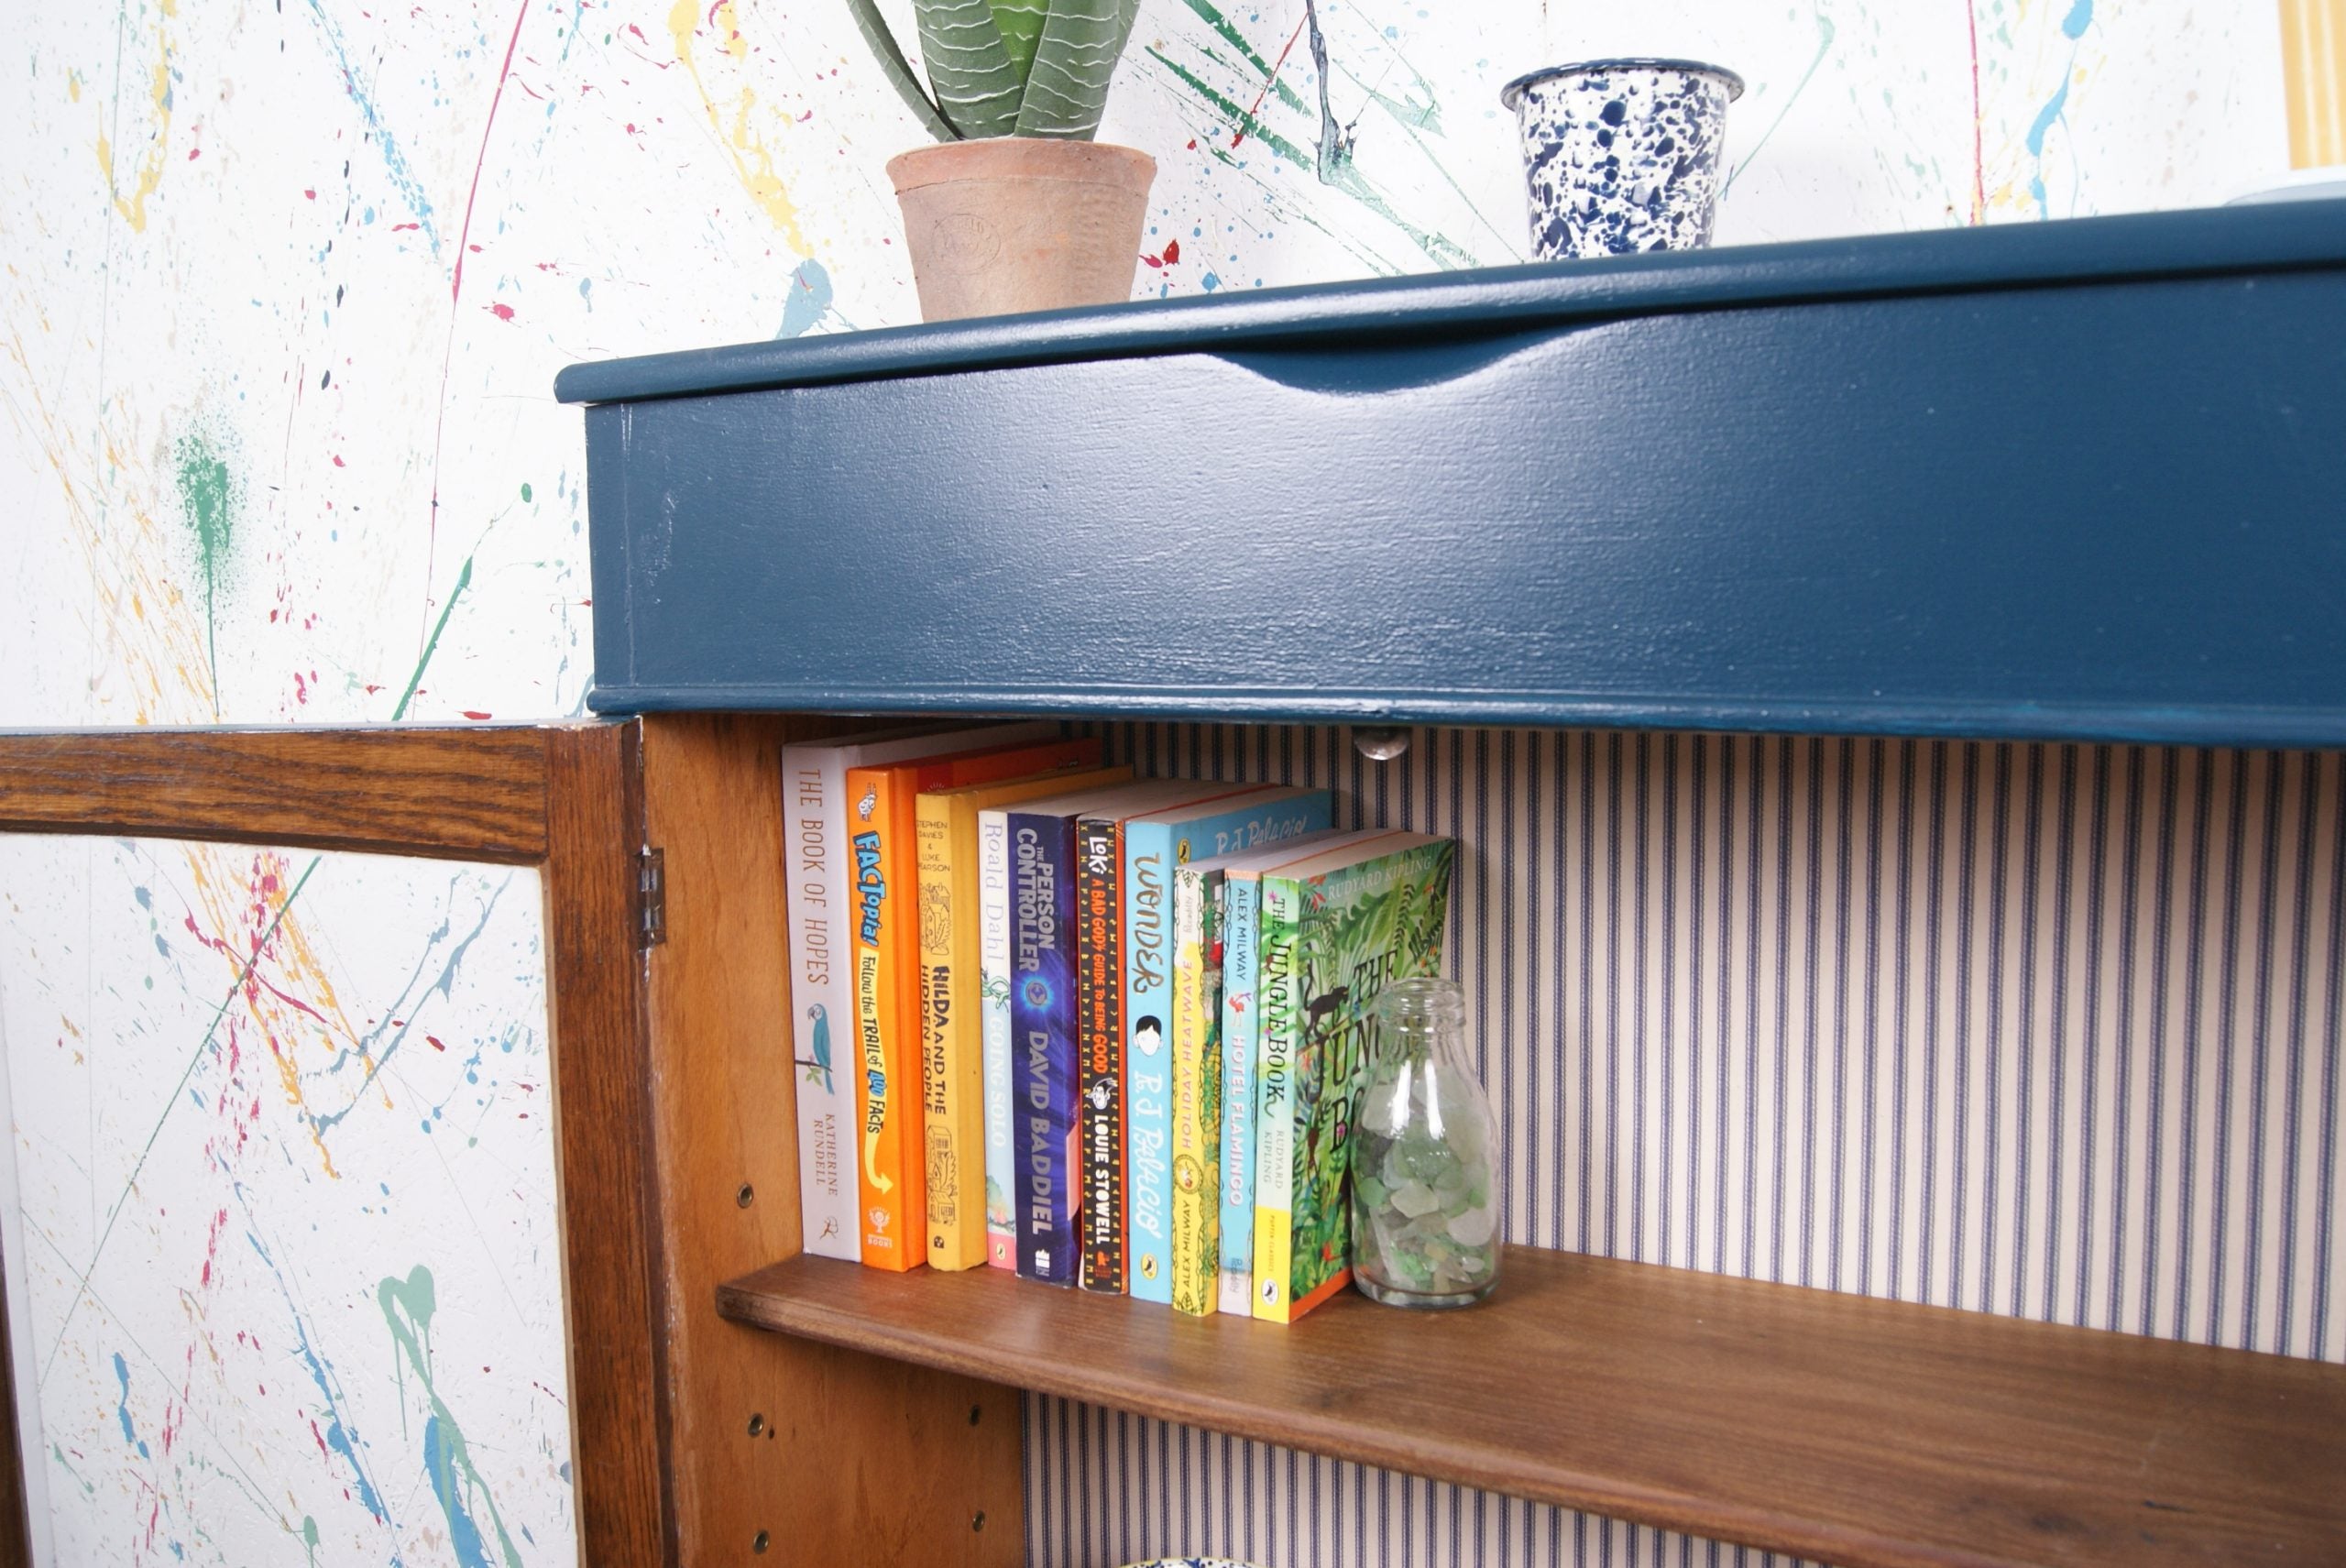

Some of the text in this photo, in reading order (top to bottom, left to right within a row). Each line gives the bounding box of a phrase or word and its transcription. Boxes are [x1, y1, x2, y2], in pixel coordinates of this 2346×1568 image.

[918, 830, 944, 839] DAVIES
[922, 853, 941, 861] LUKE
[799, 769, 828, 985] THE BOOK OF HOPES
[984, 823, 1005, 961] Roald Dahl
[1016, 828, 1040, 972] CONTROLLER
[1036, 846, 1055, 949] THE PERSON
[1091, 879, 1105, 887] A
[1091, 890, 1106, 916] BAD
[1329, 856, 1432, 901] RUDYARD KIPLING
[1236, 887, 1249, 981] ALEX MILWAY
[861, 956, 877, 992] Follow
[1093, 953, 1106, 986] GUIDE
[1354, 949, 1398, 1003] THE
[861, 995, 876, 1014] the
[863, 1018, 881, 1054] TRAIL
[1094, 1001, 1106, 1032] BEING
[1265, 897, 1291, 1118] THE JUNGLE BOOK
[868, 1055, 882, 1068] of
[921, 965, 933, 1112] HIDDEN PEOPLE
[932, 965, 951, 1115] HILDA AND THE
[1092, 1034, 1108, 1074] GOOD
[1181, 959, 1193, 1149] HOLIDAY HEATWAVE
[990, 1016, 1007, 1147] GOING SOLO
[815, 1119, 825, 1186] RUNDELL
[826, 1113, 839, 1196] KATHERINE
[1029, 1031, 1053, 1235] DAVID BADDIEL
[1229, 1036, 1246, 1207] HOTEL FLAMINGO
[1093, 1114, 1111, 1245] LOUIE STOWELL
[1263, 1131, 1273, 1184] KIPLING
[1275, 1129, 1286, 1190] RUDYARD
[1182, 1200, 1191, 1288] ALEX MILWAY
